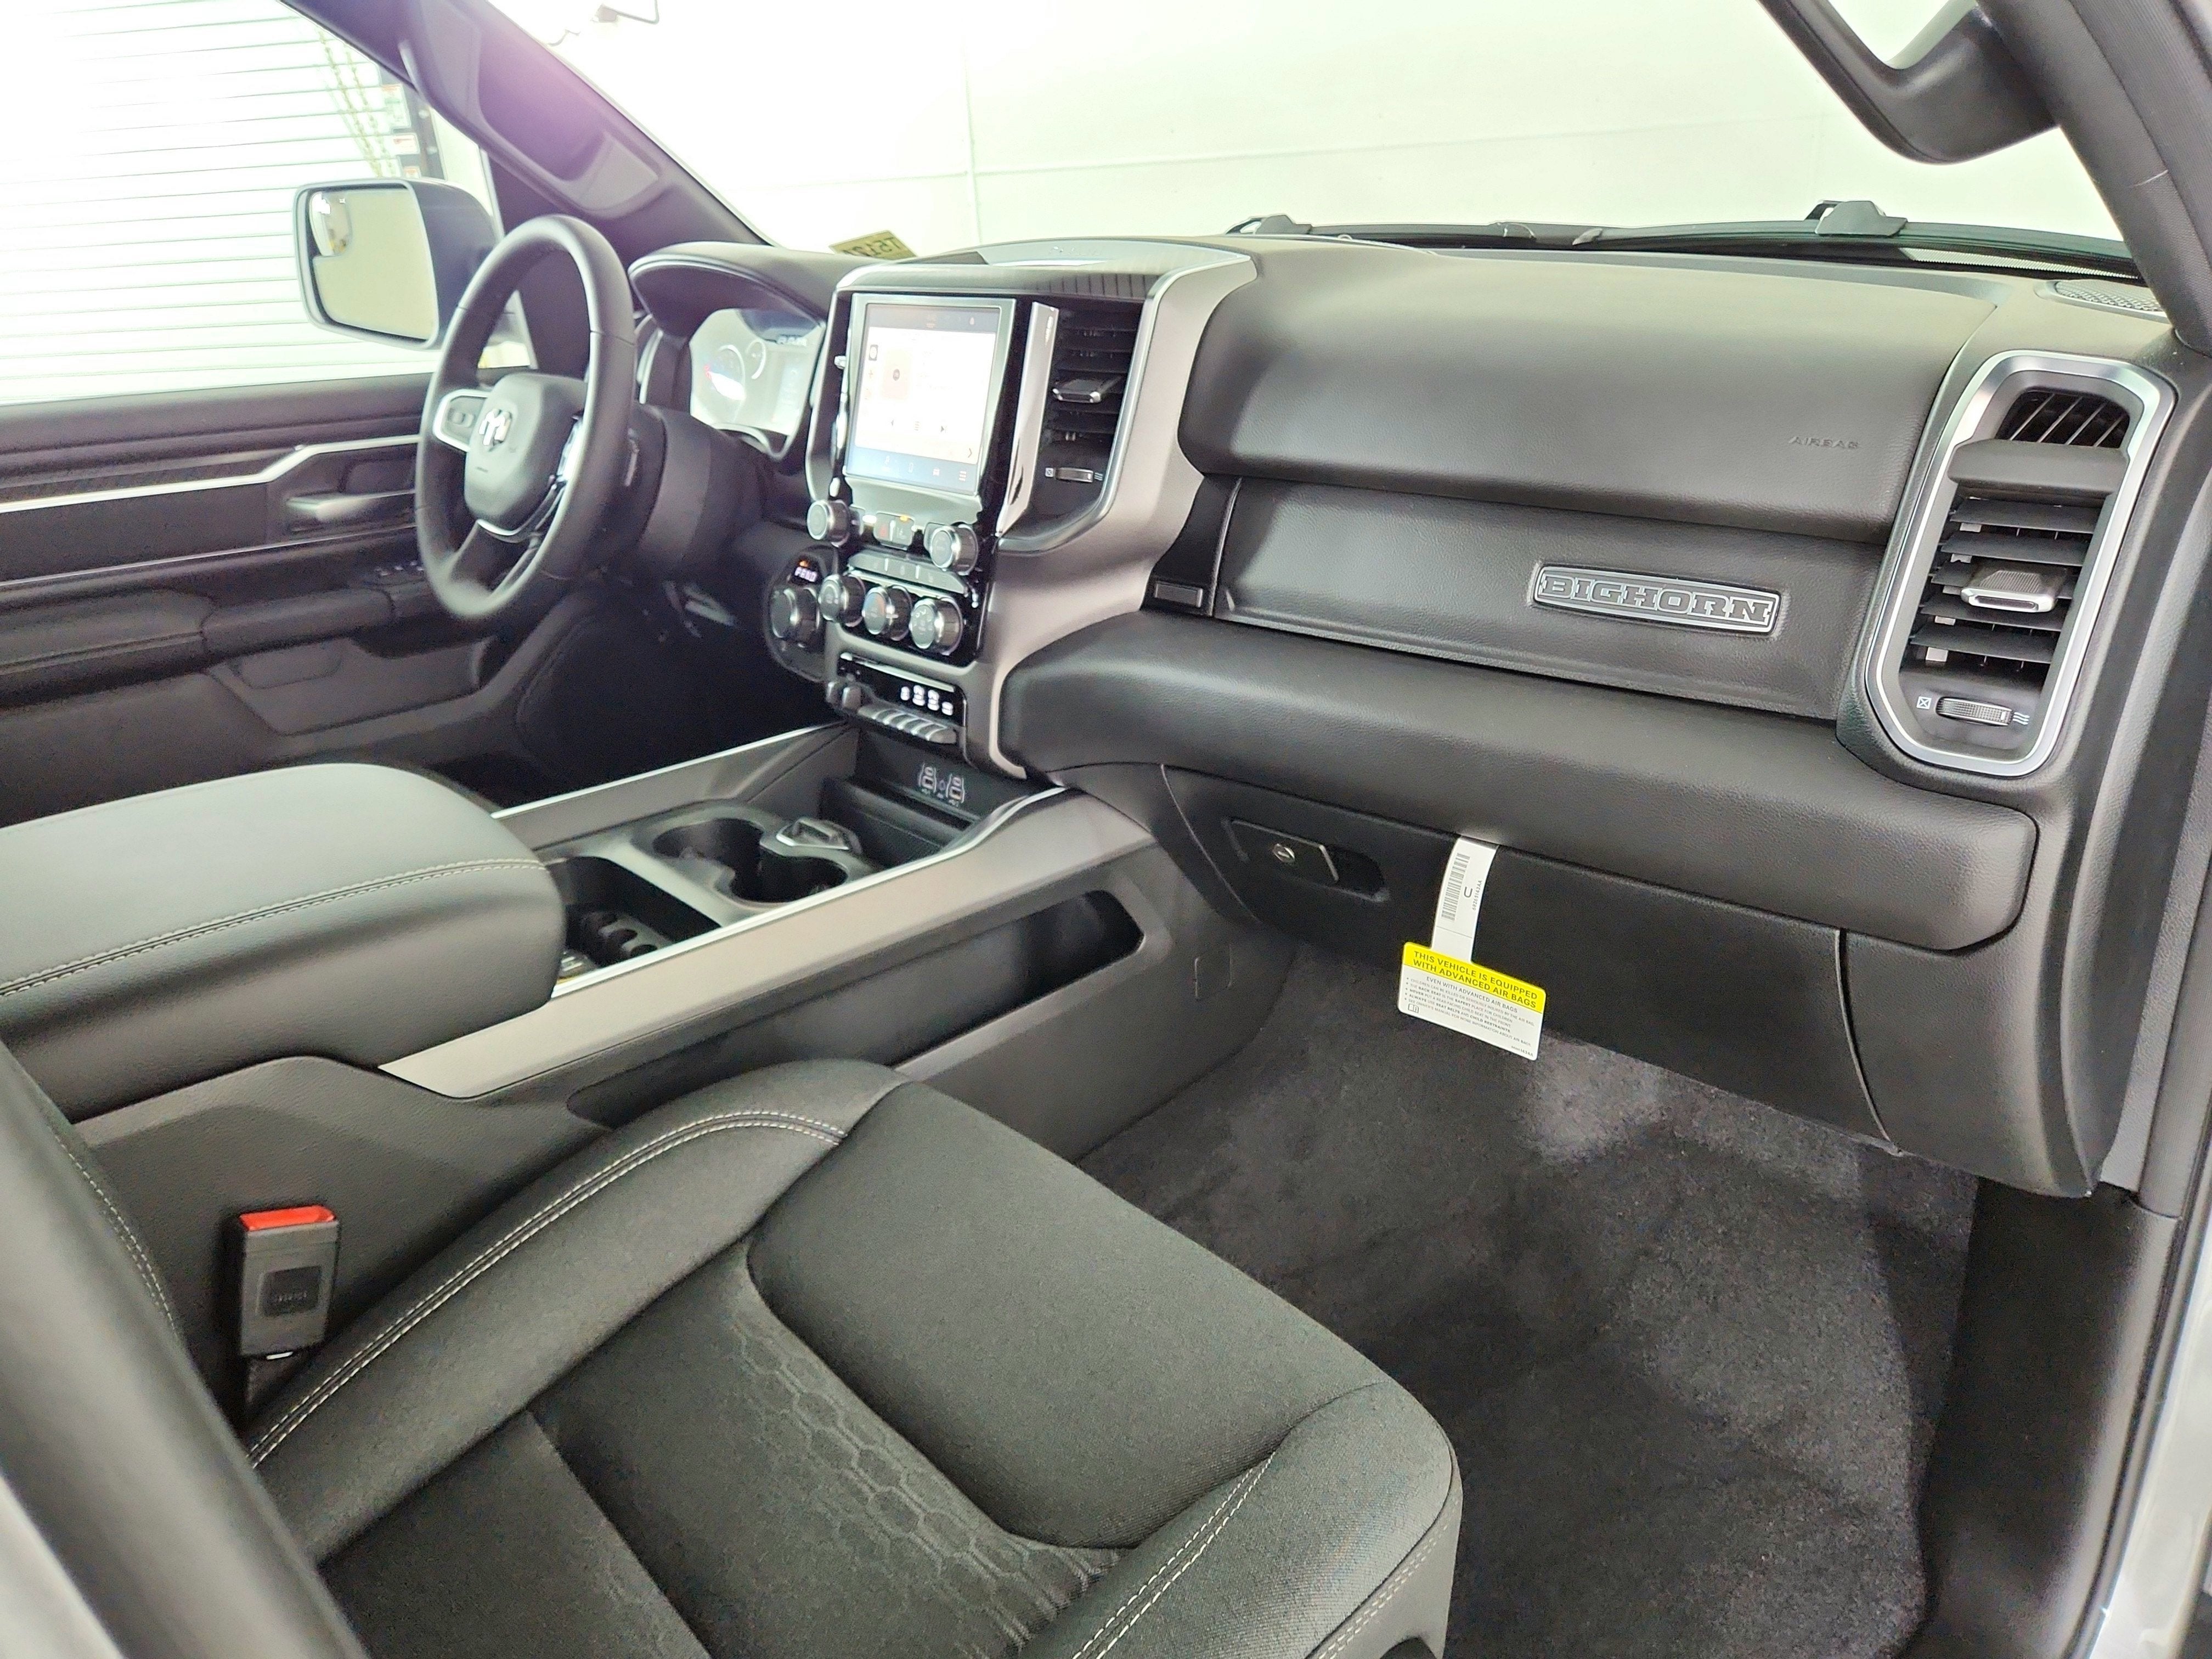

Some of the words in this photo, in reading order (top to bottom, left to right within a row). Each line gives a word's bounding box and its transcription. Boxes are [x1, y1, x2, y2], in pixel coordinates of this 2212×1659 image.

[1788, 437, 1859, 449] AIRBAG
[1539, 574, 1775, 626] BIGHORN
[1464, 886, 1473, 898] U
[1413, 958, 1437, 972] WITH
[1439, 968, 1491, 991] ADVANCED
[1493, 987, 1509, 998] AIR
[1511, 994, 1537, 1008] BAGS
[1414, 951, 1435, 963] THIS
[1437, 958, 1476, 977] VEHICLE
[1479, 973, 1487, 981] IS
[1490, 977, 1537, 1000] EQUIPPED
[1426, 977, 1441, 985] EVEN
[1443, 982, 1458, 991] WITH
[1459, 988, 1490, 1002] ADVANCED
[1502, 1003, 1517, 1013] BAGS
